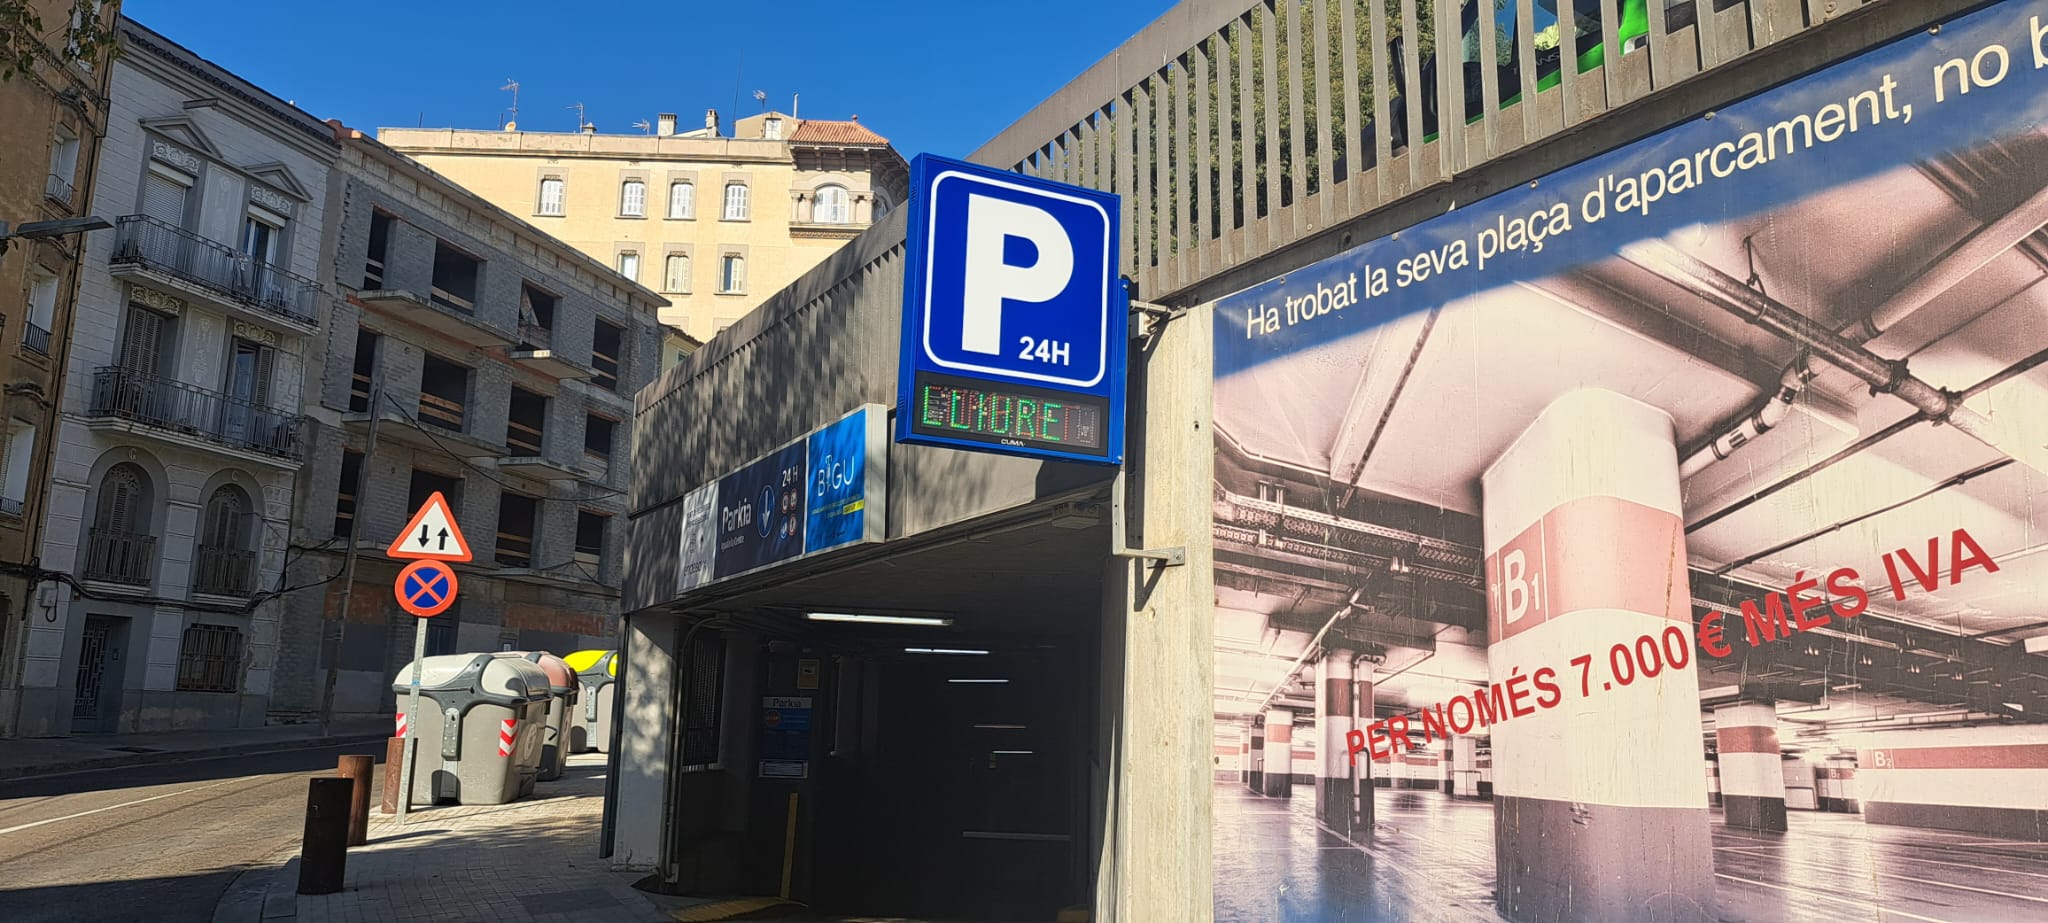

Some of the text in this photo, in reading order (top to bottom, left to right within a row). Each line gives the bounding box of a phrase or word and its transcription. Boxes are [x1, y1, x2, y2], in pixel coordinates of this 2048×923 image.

[1246, 303, 1281, 339] Ha
[1285, 274, 1359, 327] trobat
[1363, 262, 1389, 298] la
[1395, 240, 1468, 280] seva
[1477, 203, 1571, 272] plaça
[1582, 73, 1914, 222] d'aparcament,
[1934, 42, 2009, 103] no
[962, 193, 1074, 355] P
[1018, 335, 1071, 366] 24H
[1000, 438, 1024, 447] CUMA
[781, 465, 799, 487] 24 H
[722, 497, 752, 534] Parkia
[1345, 527, 2000, 766] PER NOMÉS 7.000 € MÉS IVA
